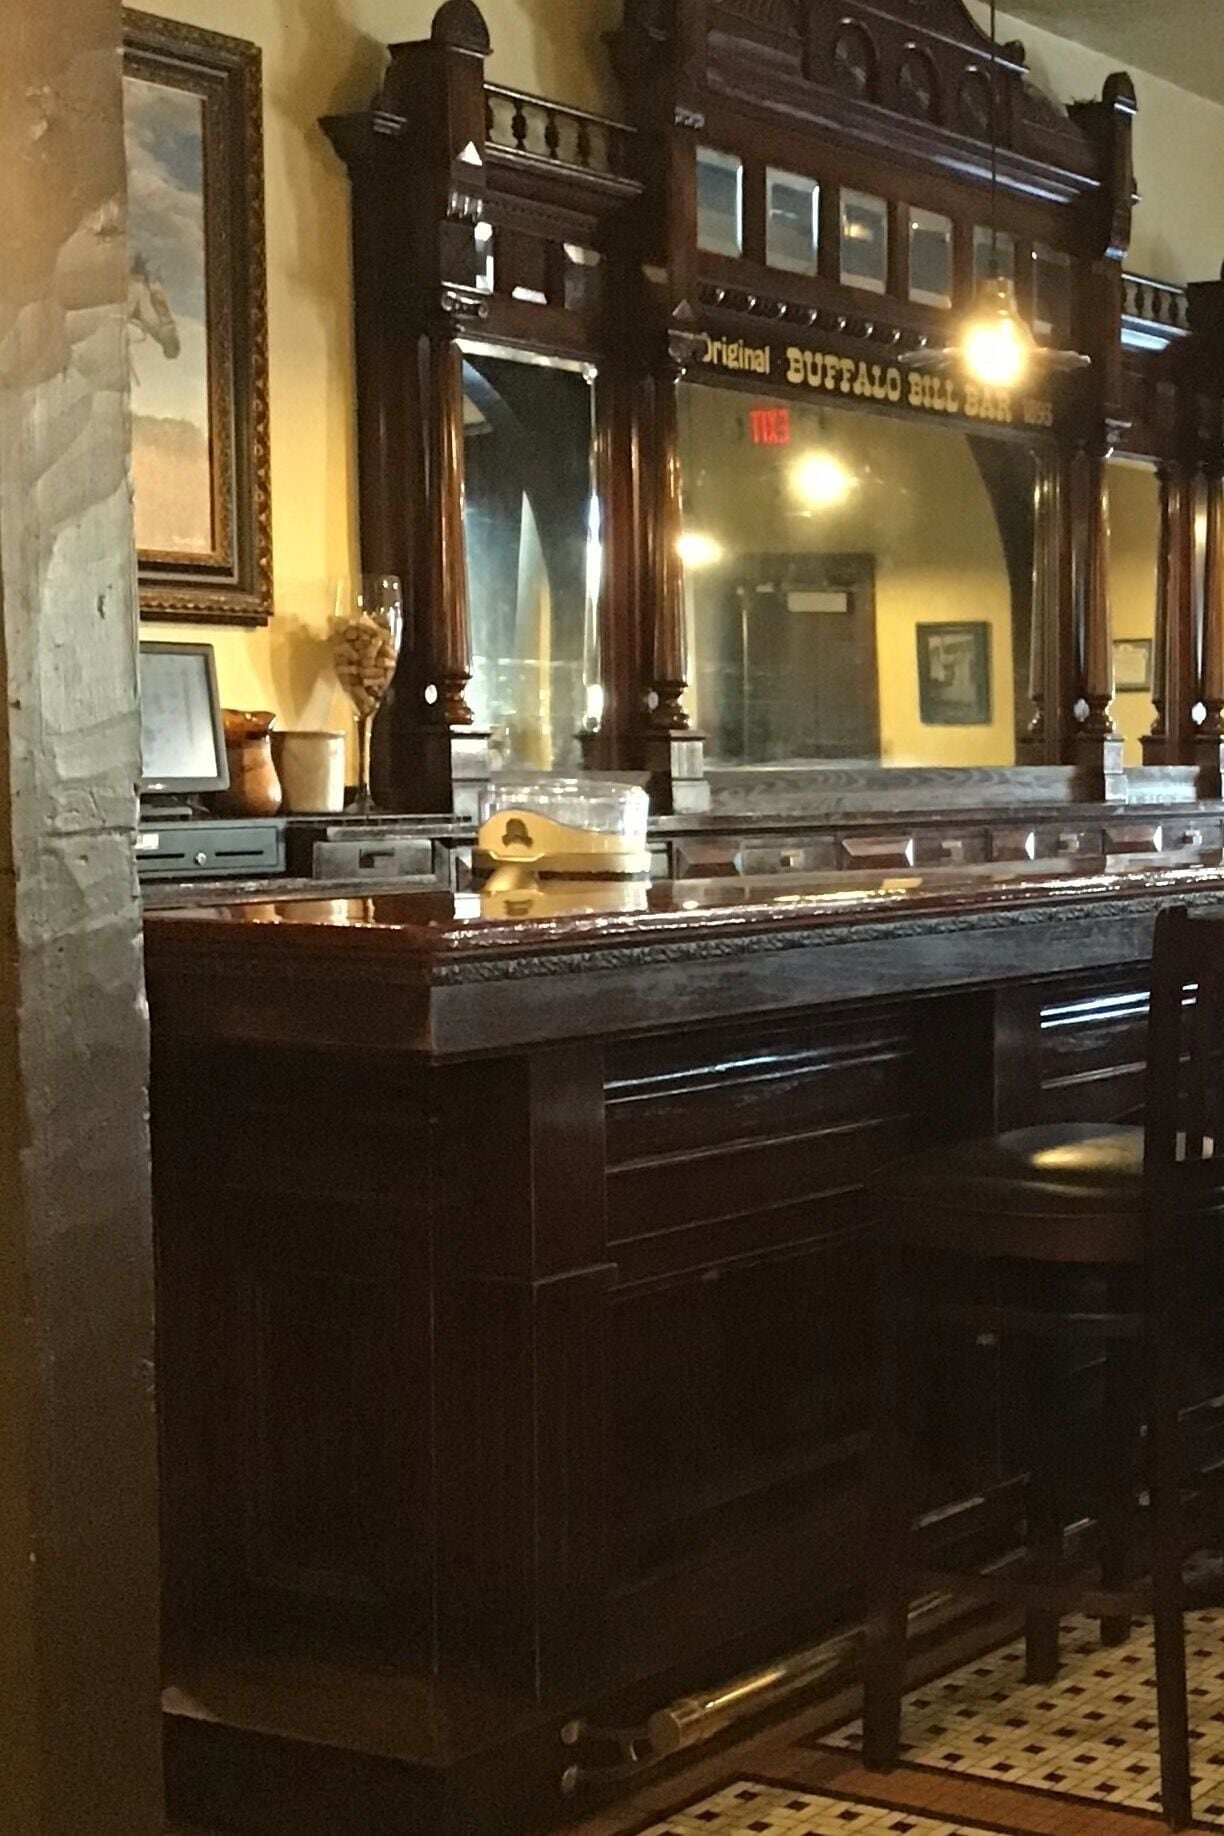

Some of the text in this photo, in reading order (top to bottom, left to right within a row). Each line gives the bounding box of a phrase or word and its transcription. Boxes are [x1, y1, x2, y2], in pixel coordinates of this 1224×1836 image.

[786, 347, 901, 402] BUFFALO
[908, 371, 959, 413] BILL
[964, 384, 1012, 423] BAR
